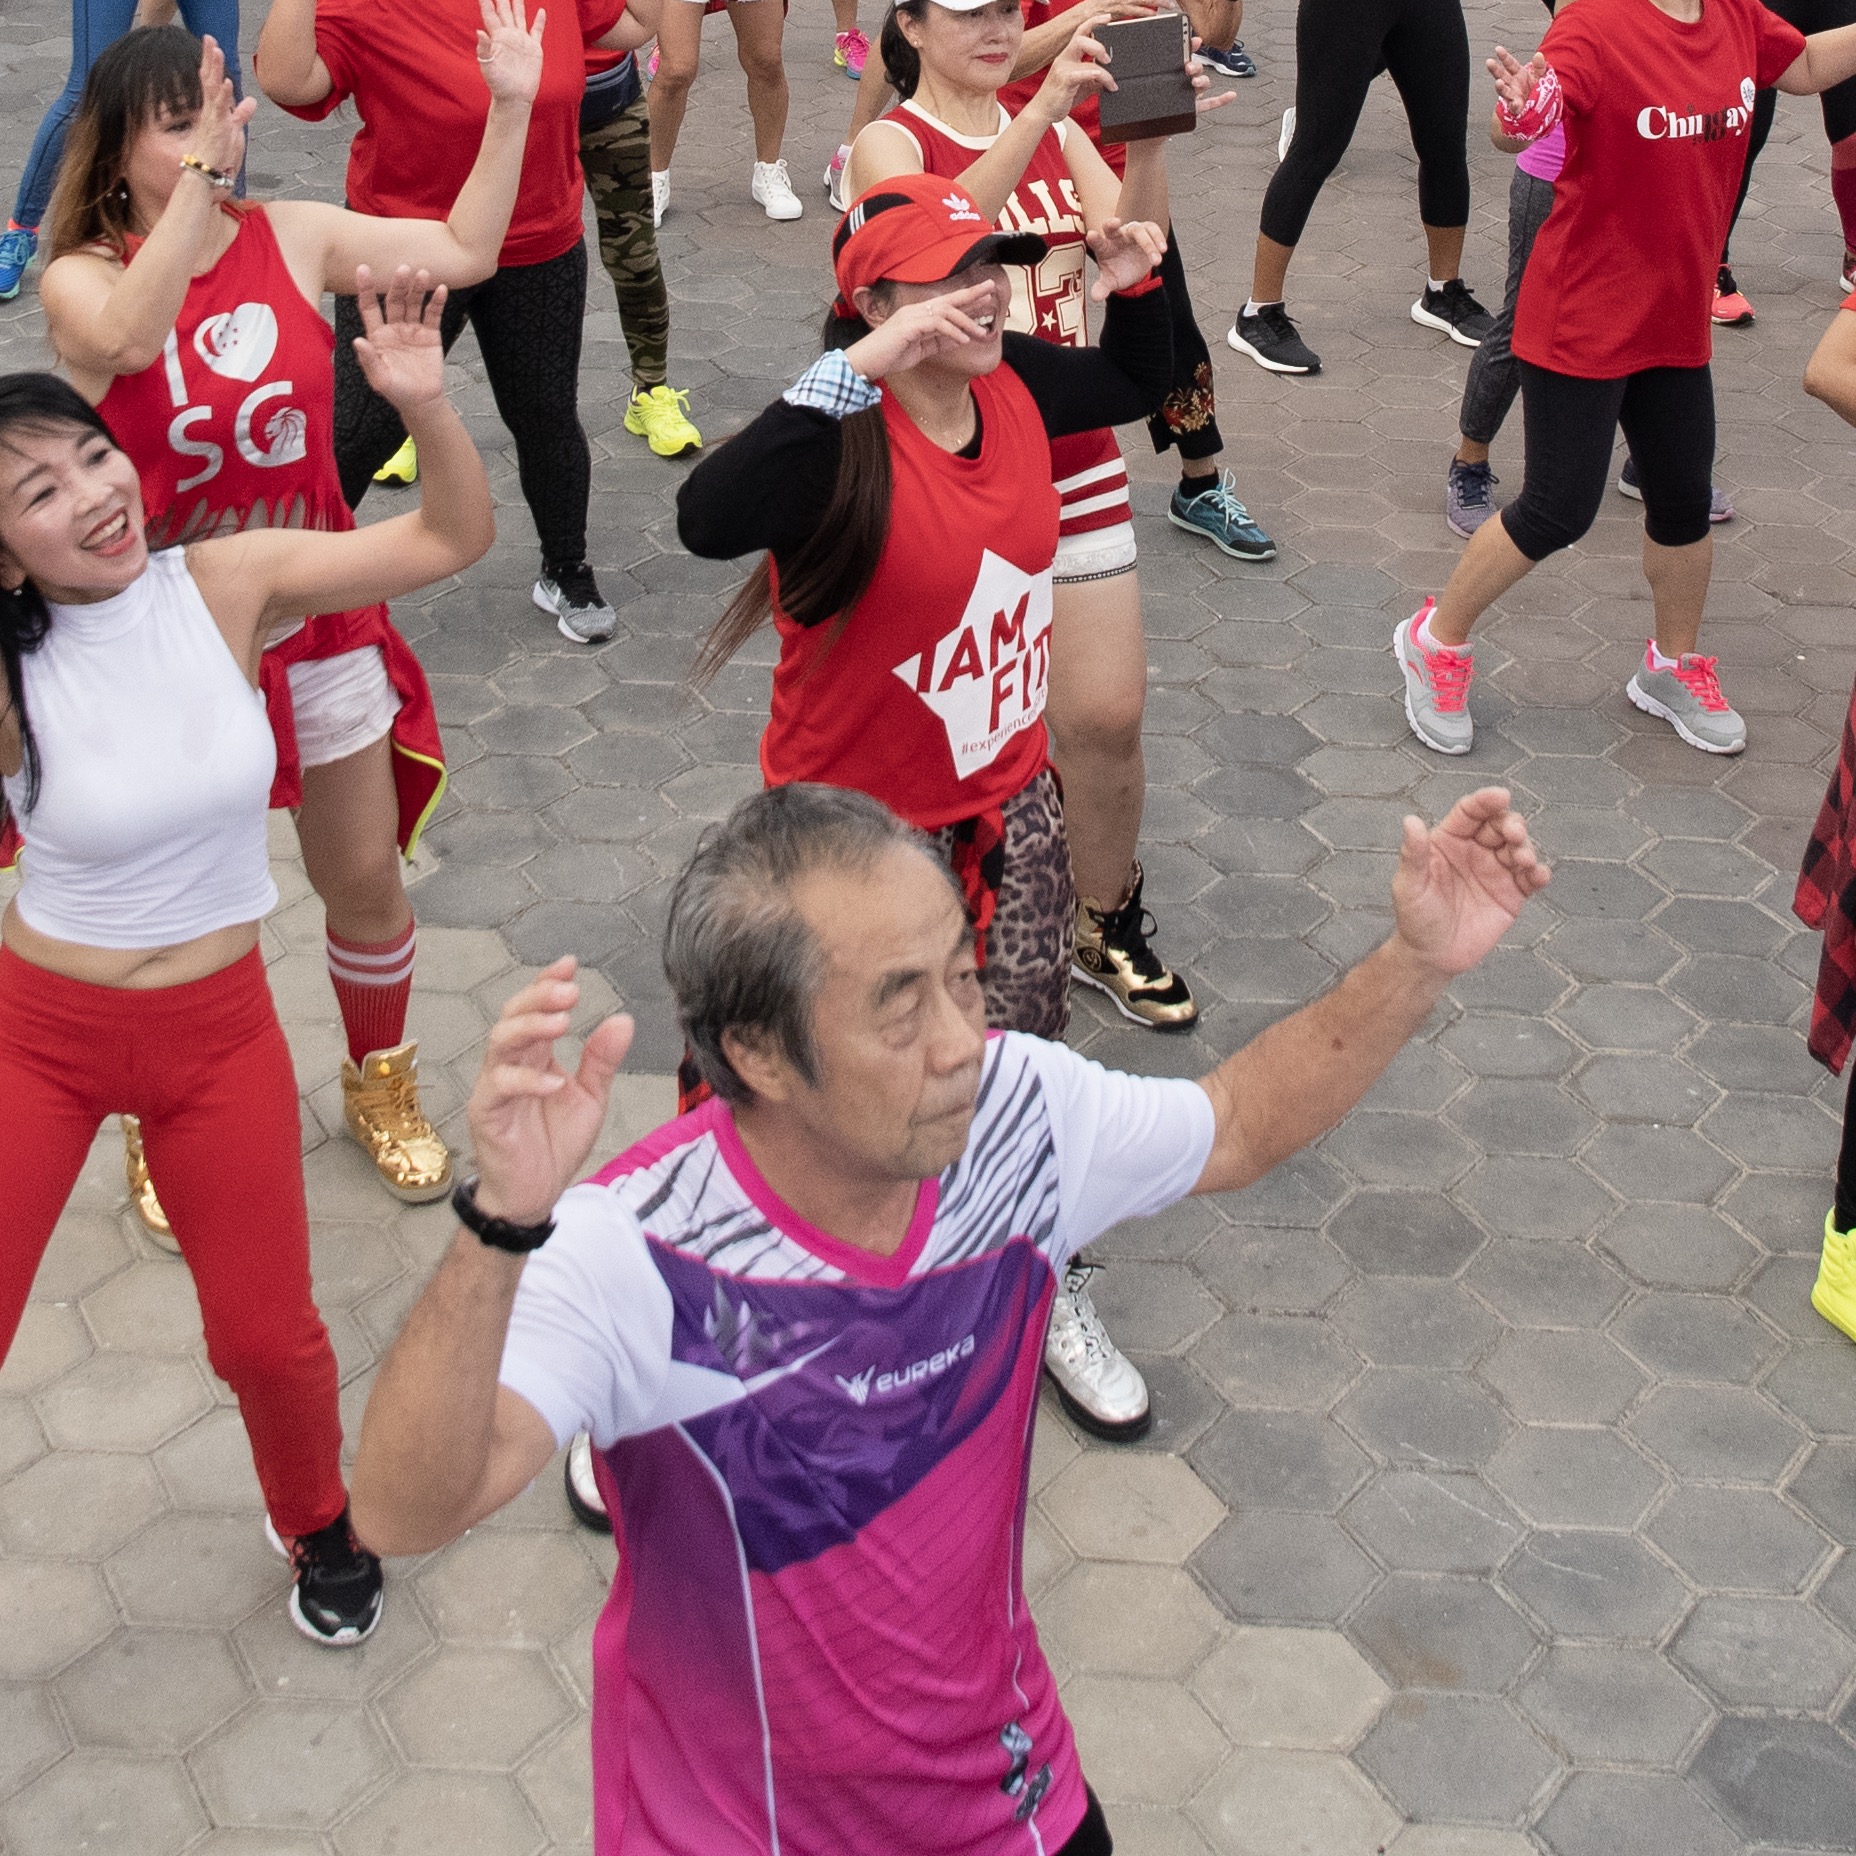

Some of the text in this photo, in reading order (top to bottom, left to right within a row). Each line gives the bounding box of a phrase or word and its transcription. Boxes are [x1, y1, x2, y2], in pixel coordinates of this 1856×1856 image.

[164, 325, 189, 407] I
[166, 380, 308, 494] SG
[939, 595, 1028, 693] AM
